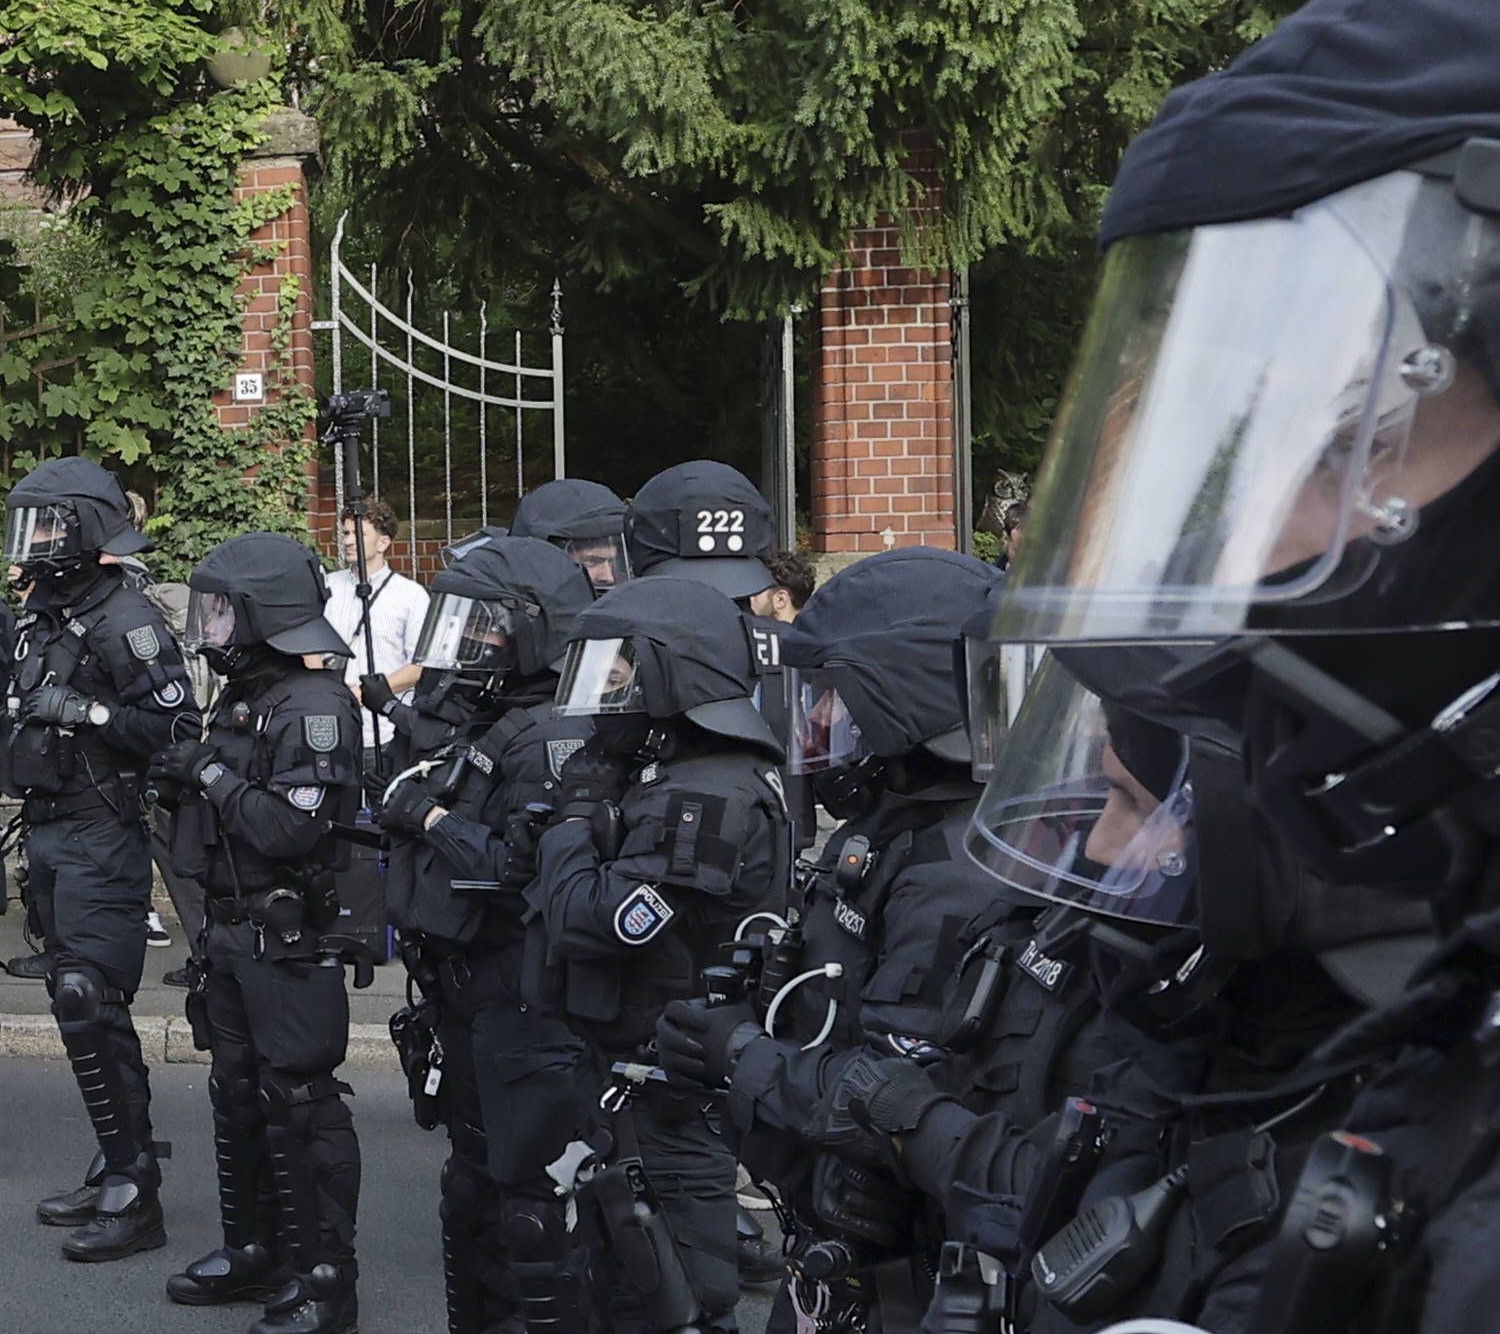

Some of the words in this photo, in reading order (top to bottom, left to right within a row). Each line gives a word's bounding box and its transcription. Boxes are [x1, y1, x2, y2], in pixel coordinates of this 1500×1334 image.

[239, 379, 258, 395] 35
[696, 509, 745, 533] 222
[638, 887, 670, 920] POLIZEI
